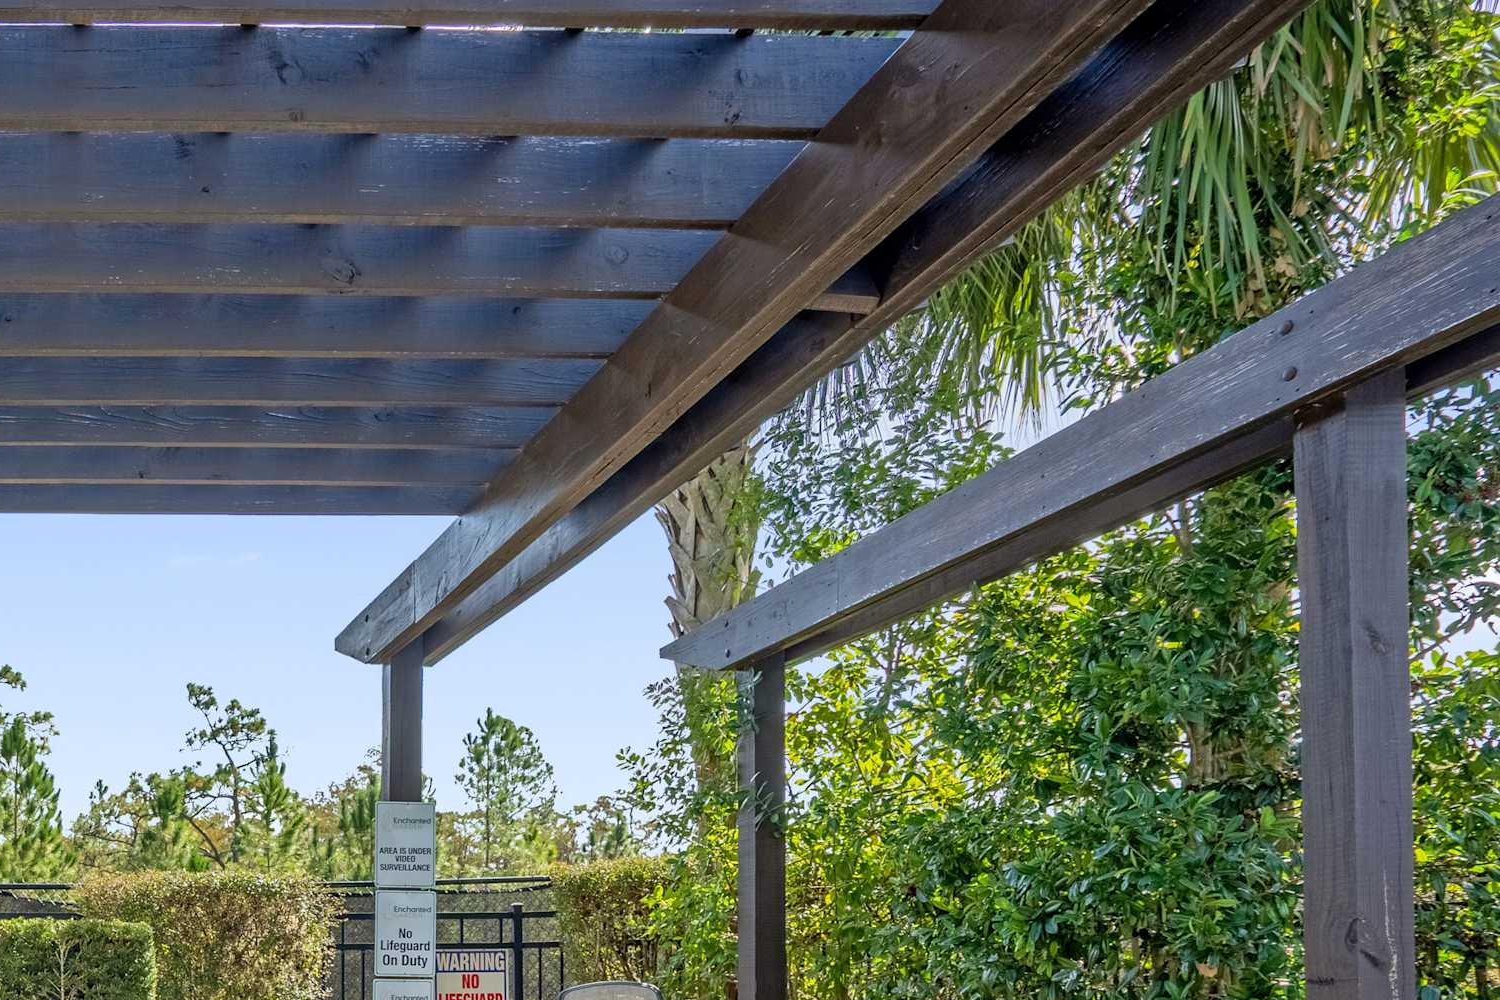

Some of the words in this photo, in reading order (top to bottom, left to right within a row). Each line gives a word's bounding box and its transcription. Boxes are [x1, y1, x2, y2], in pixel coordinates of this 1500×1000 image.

[398, 928, 412, 938] No
[380, 940, 430, 952] Lifeguard
[383, 954, 398, 966] On
[402, 954, 428, 968] Duty
[436, 952, 505, 971] WARNING
[462, 974, 480, 989] NO
